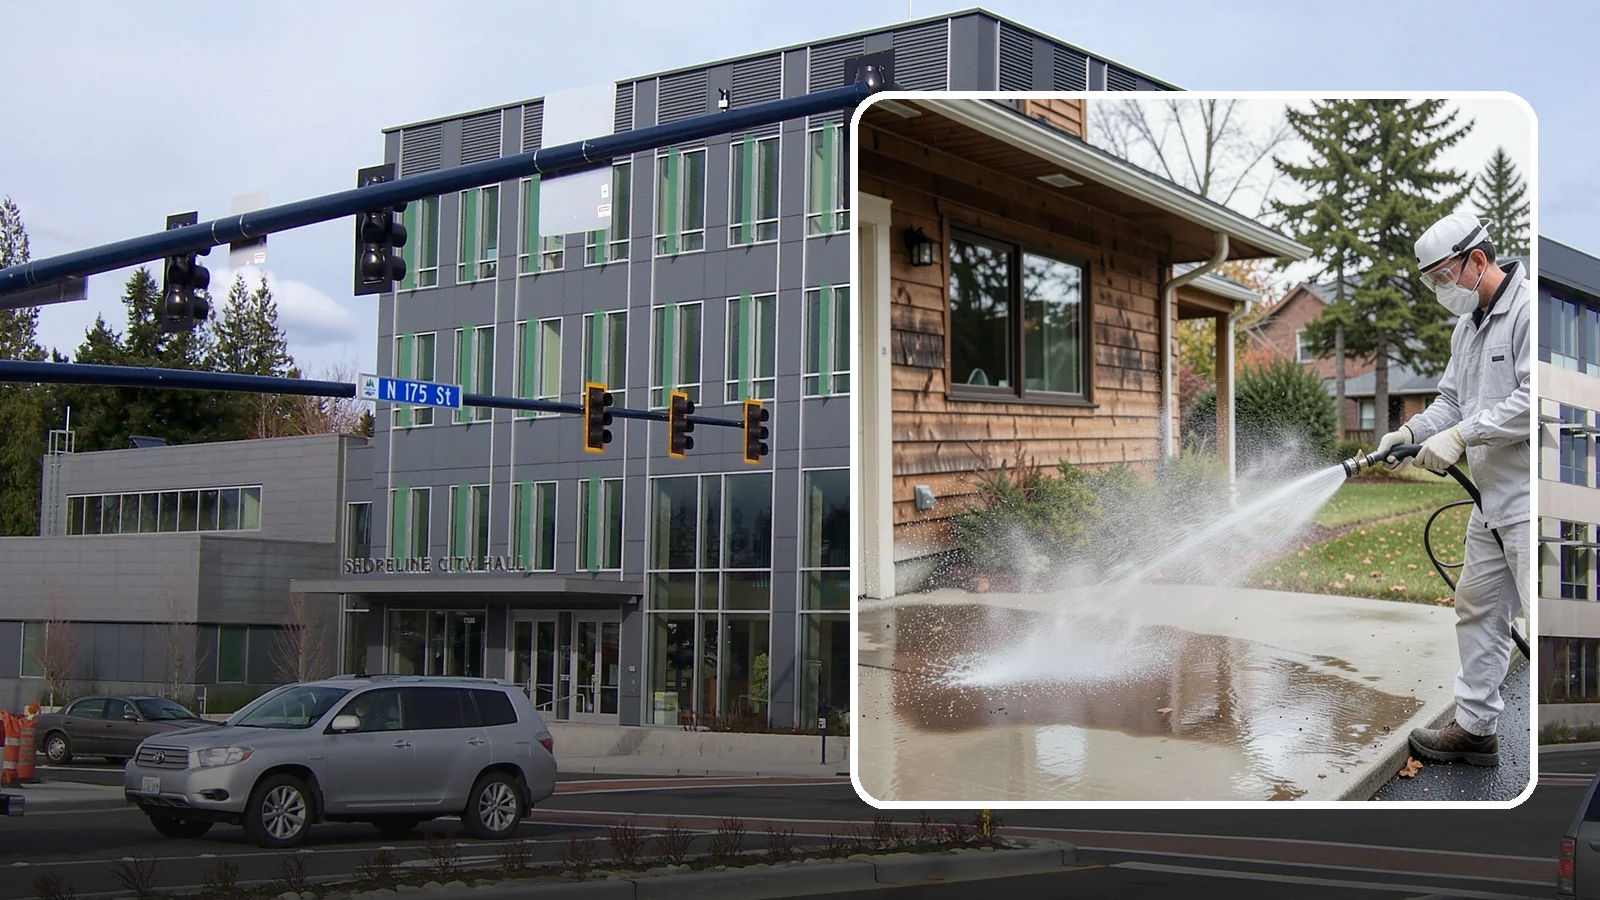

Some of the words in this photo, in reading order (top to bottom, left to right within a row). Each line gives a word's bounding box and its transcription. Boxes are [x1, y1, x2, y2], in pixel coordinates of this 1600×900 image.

[387, 380, 396, 399] N
[405, 382, 428, 403] 175
[436, 386, 452, 405] St
[344, 557, 432, 574] SHORELINE
[438, 556, 476, 573] CITY
[484, 555, 526, 572] HALL
